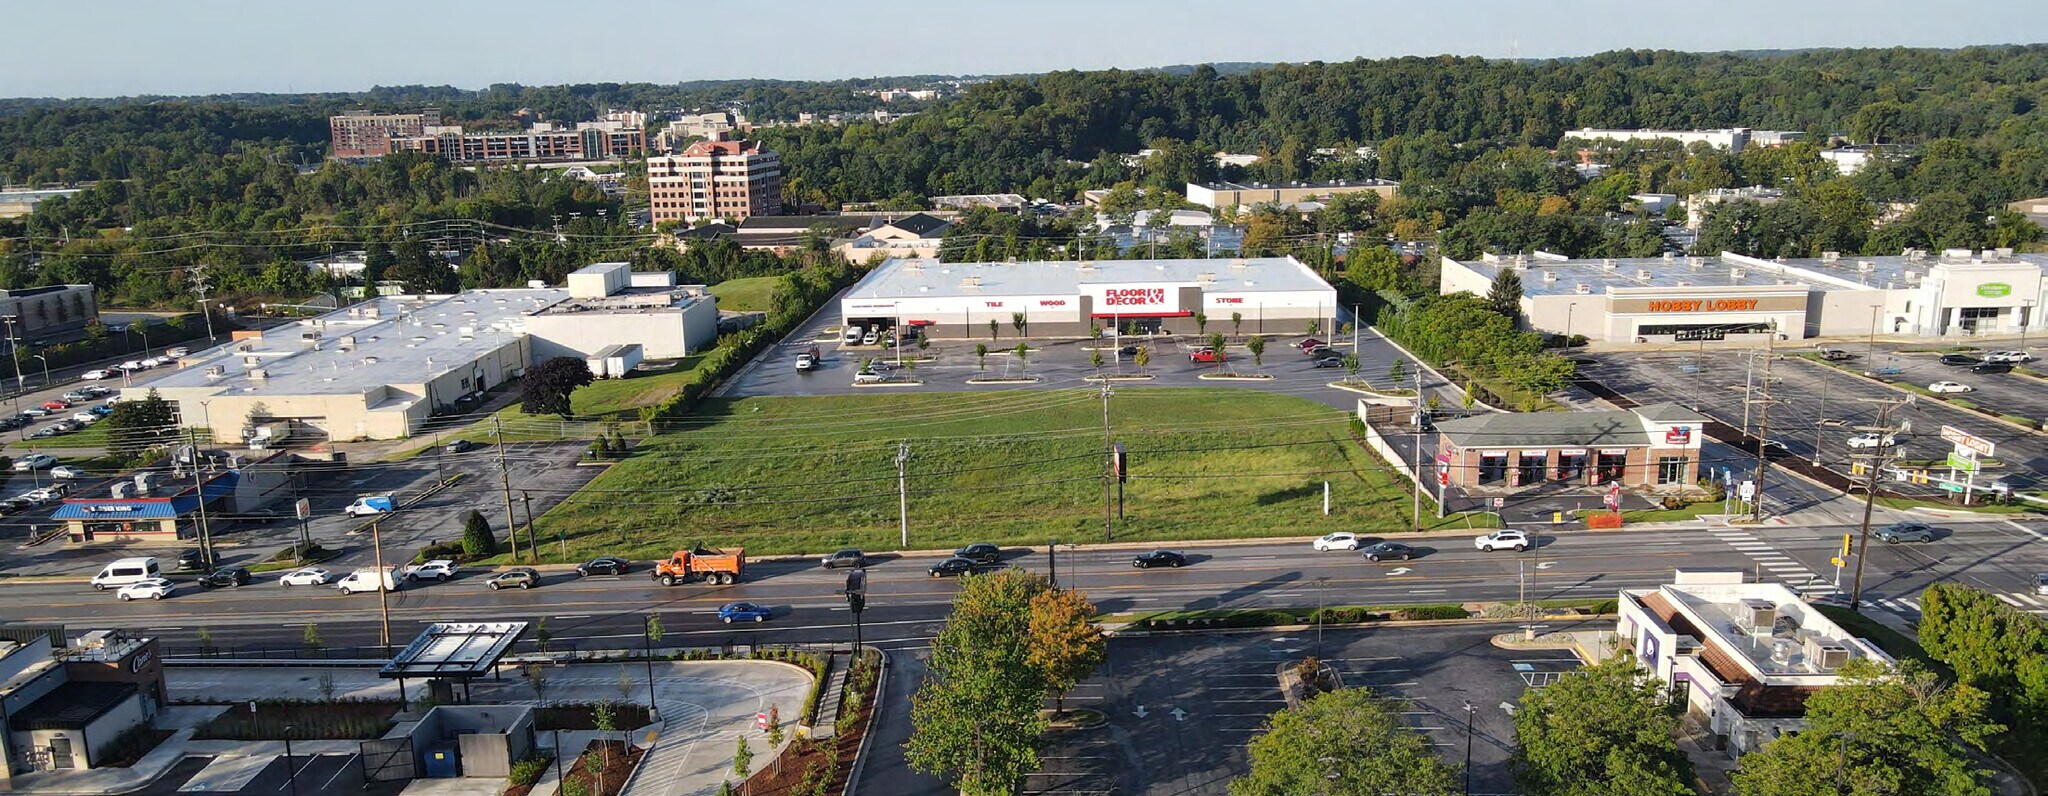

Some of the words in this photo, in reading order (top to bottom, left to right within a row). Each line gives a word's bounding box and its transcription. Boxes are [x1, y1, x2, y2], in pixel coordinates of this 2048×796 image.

[1106, 289, 1146, 297] FLOOR
[1106, 297, 1146, 305] DECOR
[1649, 299, 1702, 311] HOBBY
[1706, 299, 1758, 311] LOBBY
[1966, 436, 1989, 453] LOBBY
